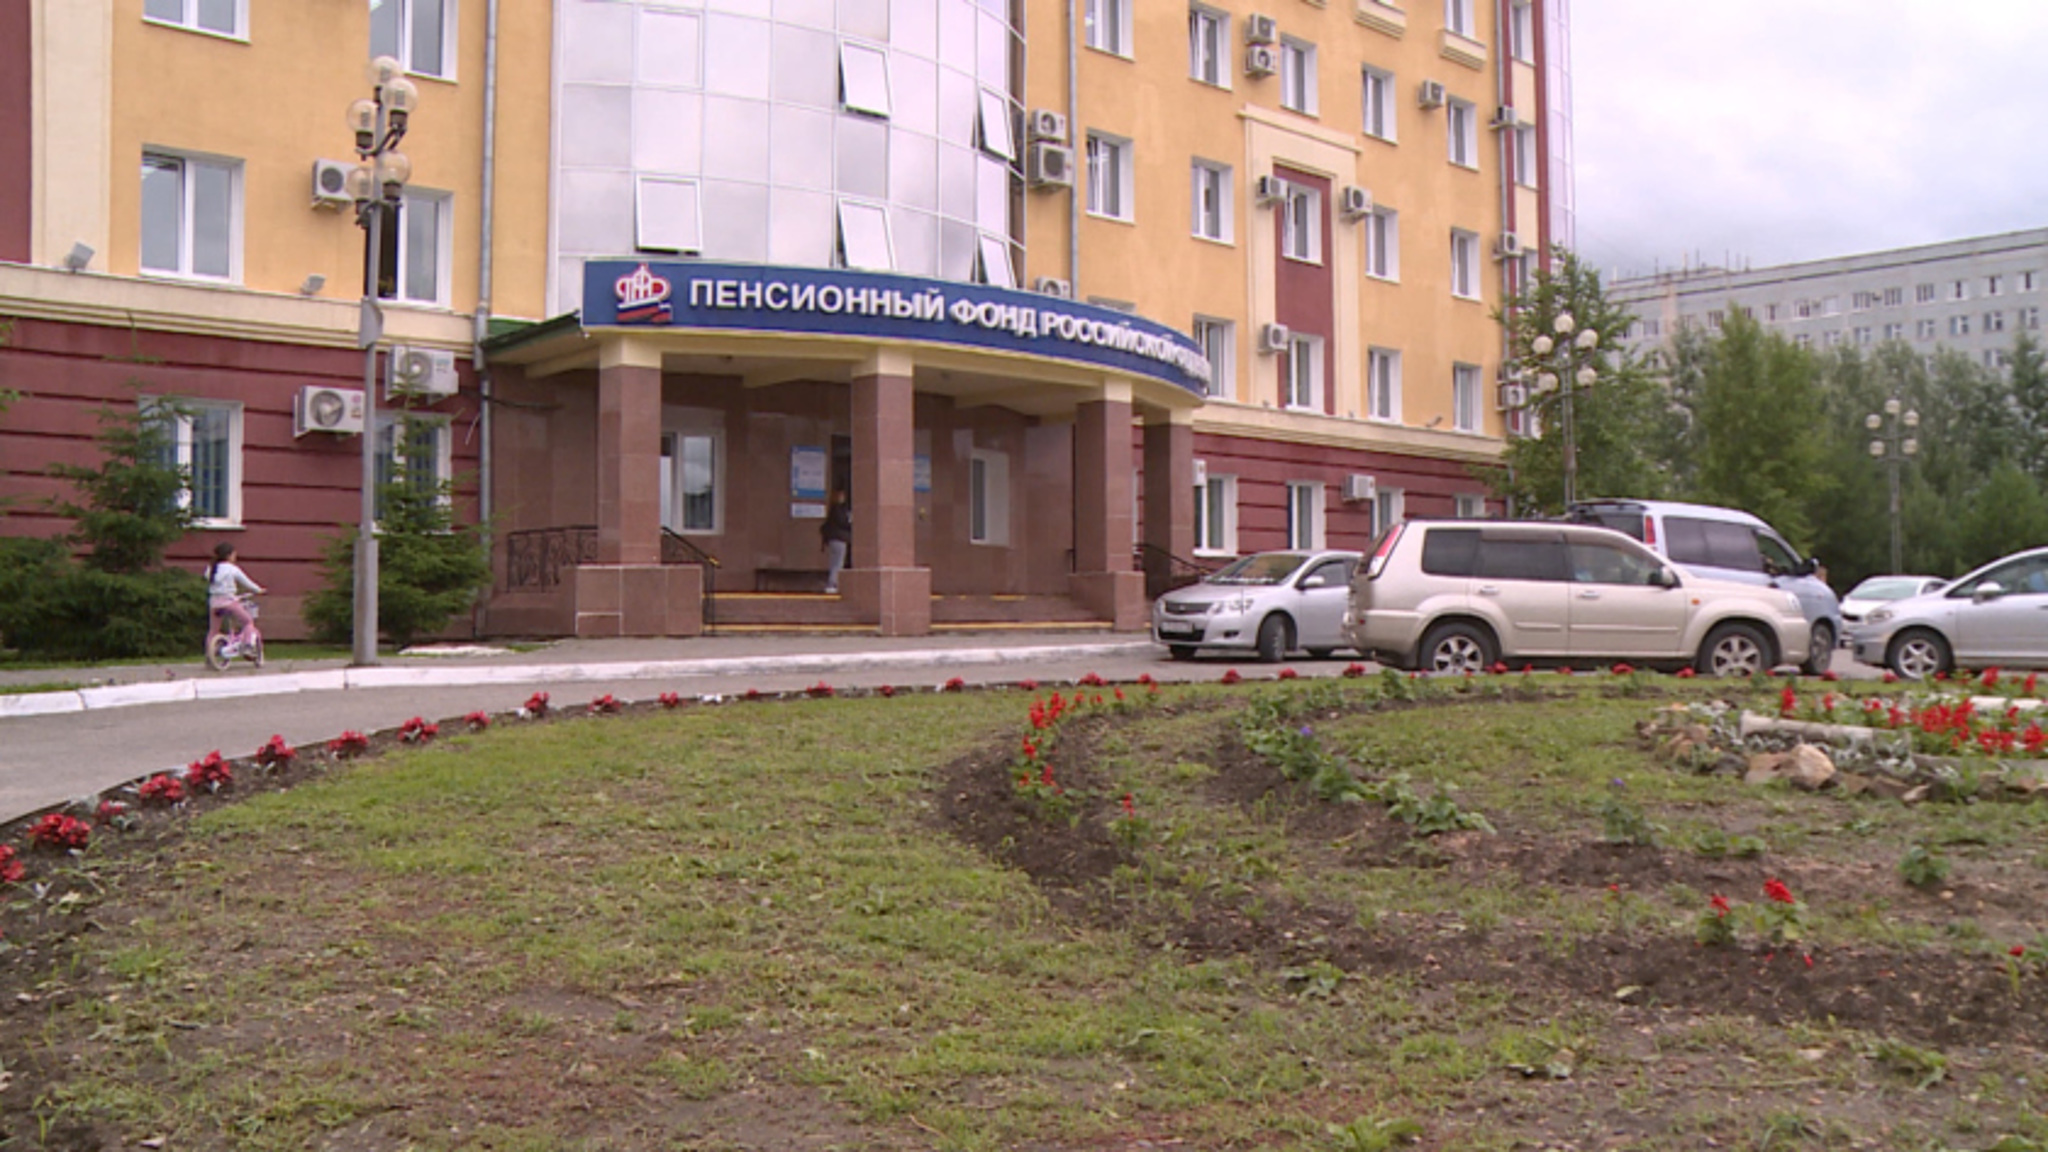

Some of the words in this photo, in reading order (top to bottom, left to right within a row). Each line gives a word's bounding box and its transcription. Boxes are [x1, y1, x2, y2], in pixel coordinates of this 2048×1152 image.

[689, 279, 944, 320] ПЕНСИОННЫЙ
[949, 298, 1038, 337] ФОНД
[1040, 315, 1176, 363] РОССИЙСКОЙ
